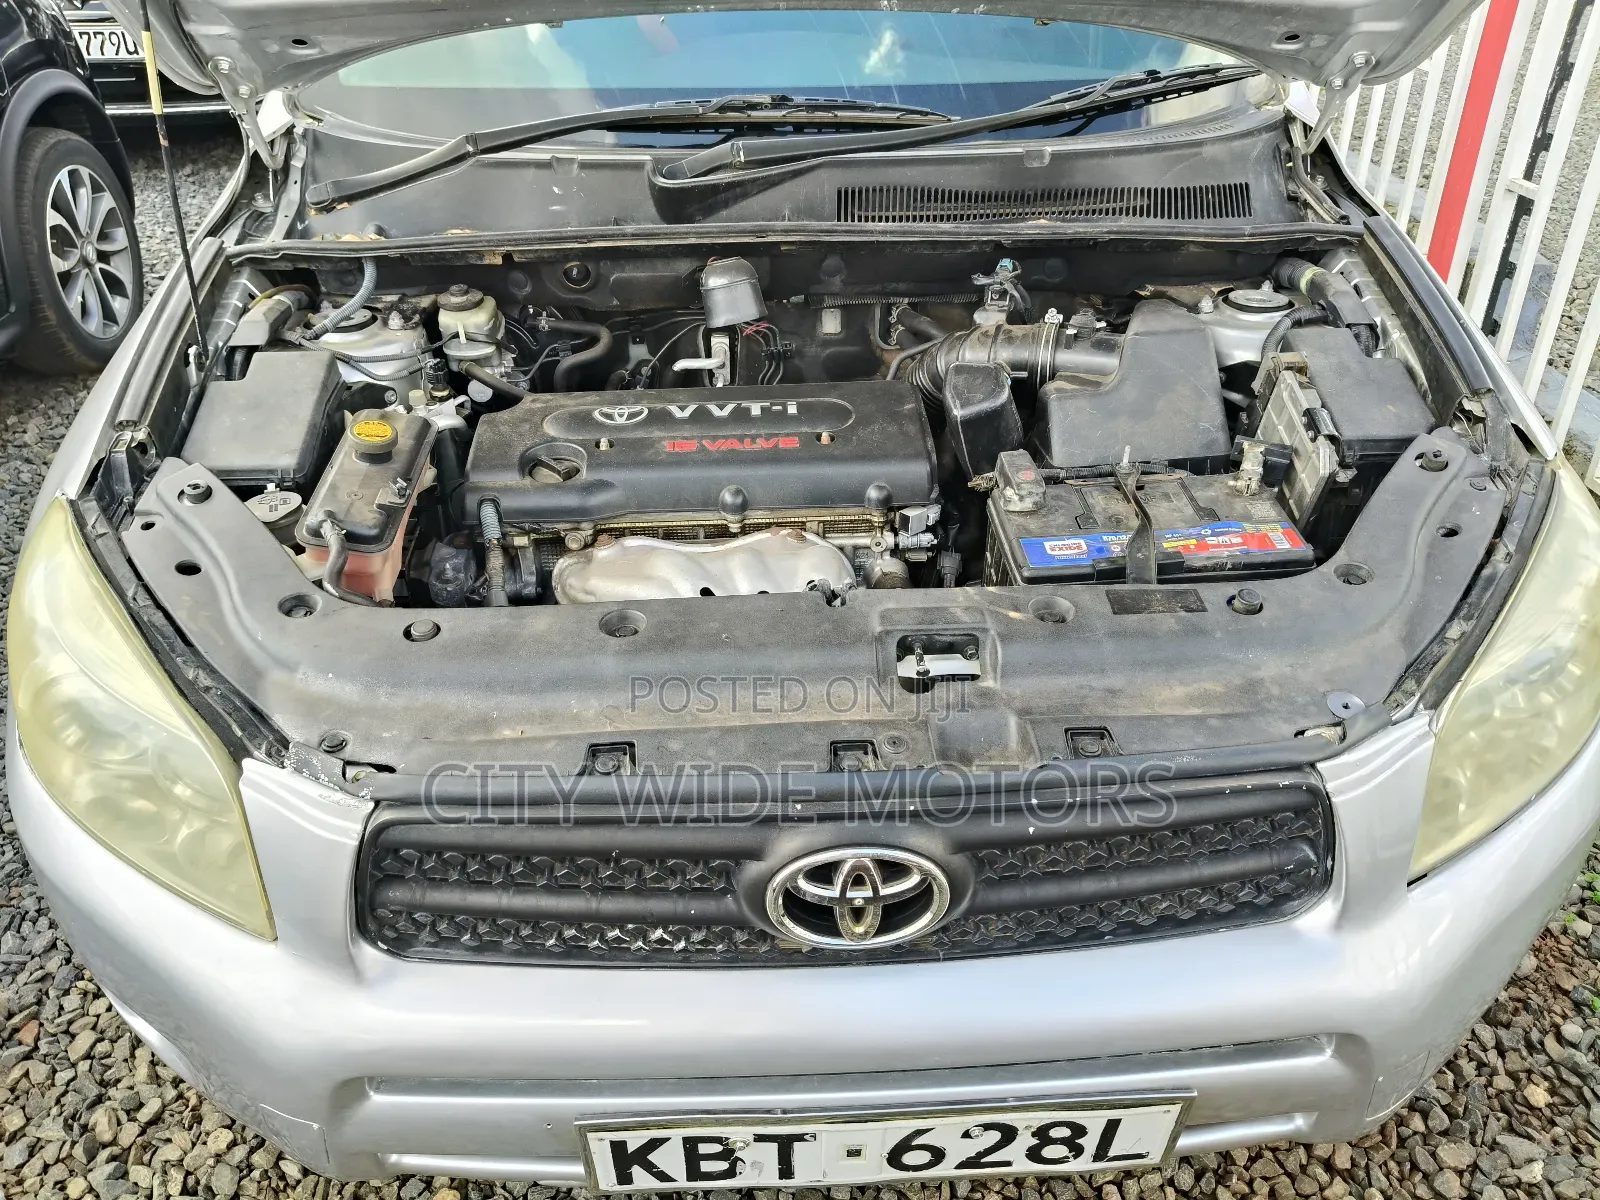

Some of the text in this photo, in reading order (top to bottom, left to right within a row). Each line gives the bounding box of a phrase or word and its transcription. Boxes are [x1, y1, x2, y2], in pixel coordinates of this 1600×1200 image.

[666, 402, 798, 419] VVT-i
[666, 437, 800, 452] 16 VALVE
[609, 1118, 1150, 1186] KBT 628L
